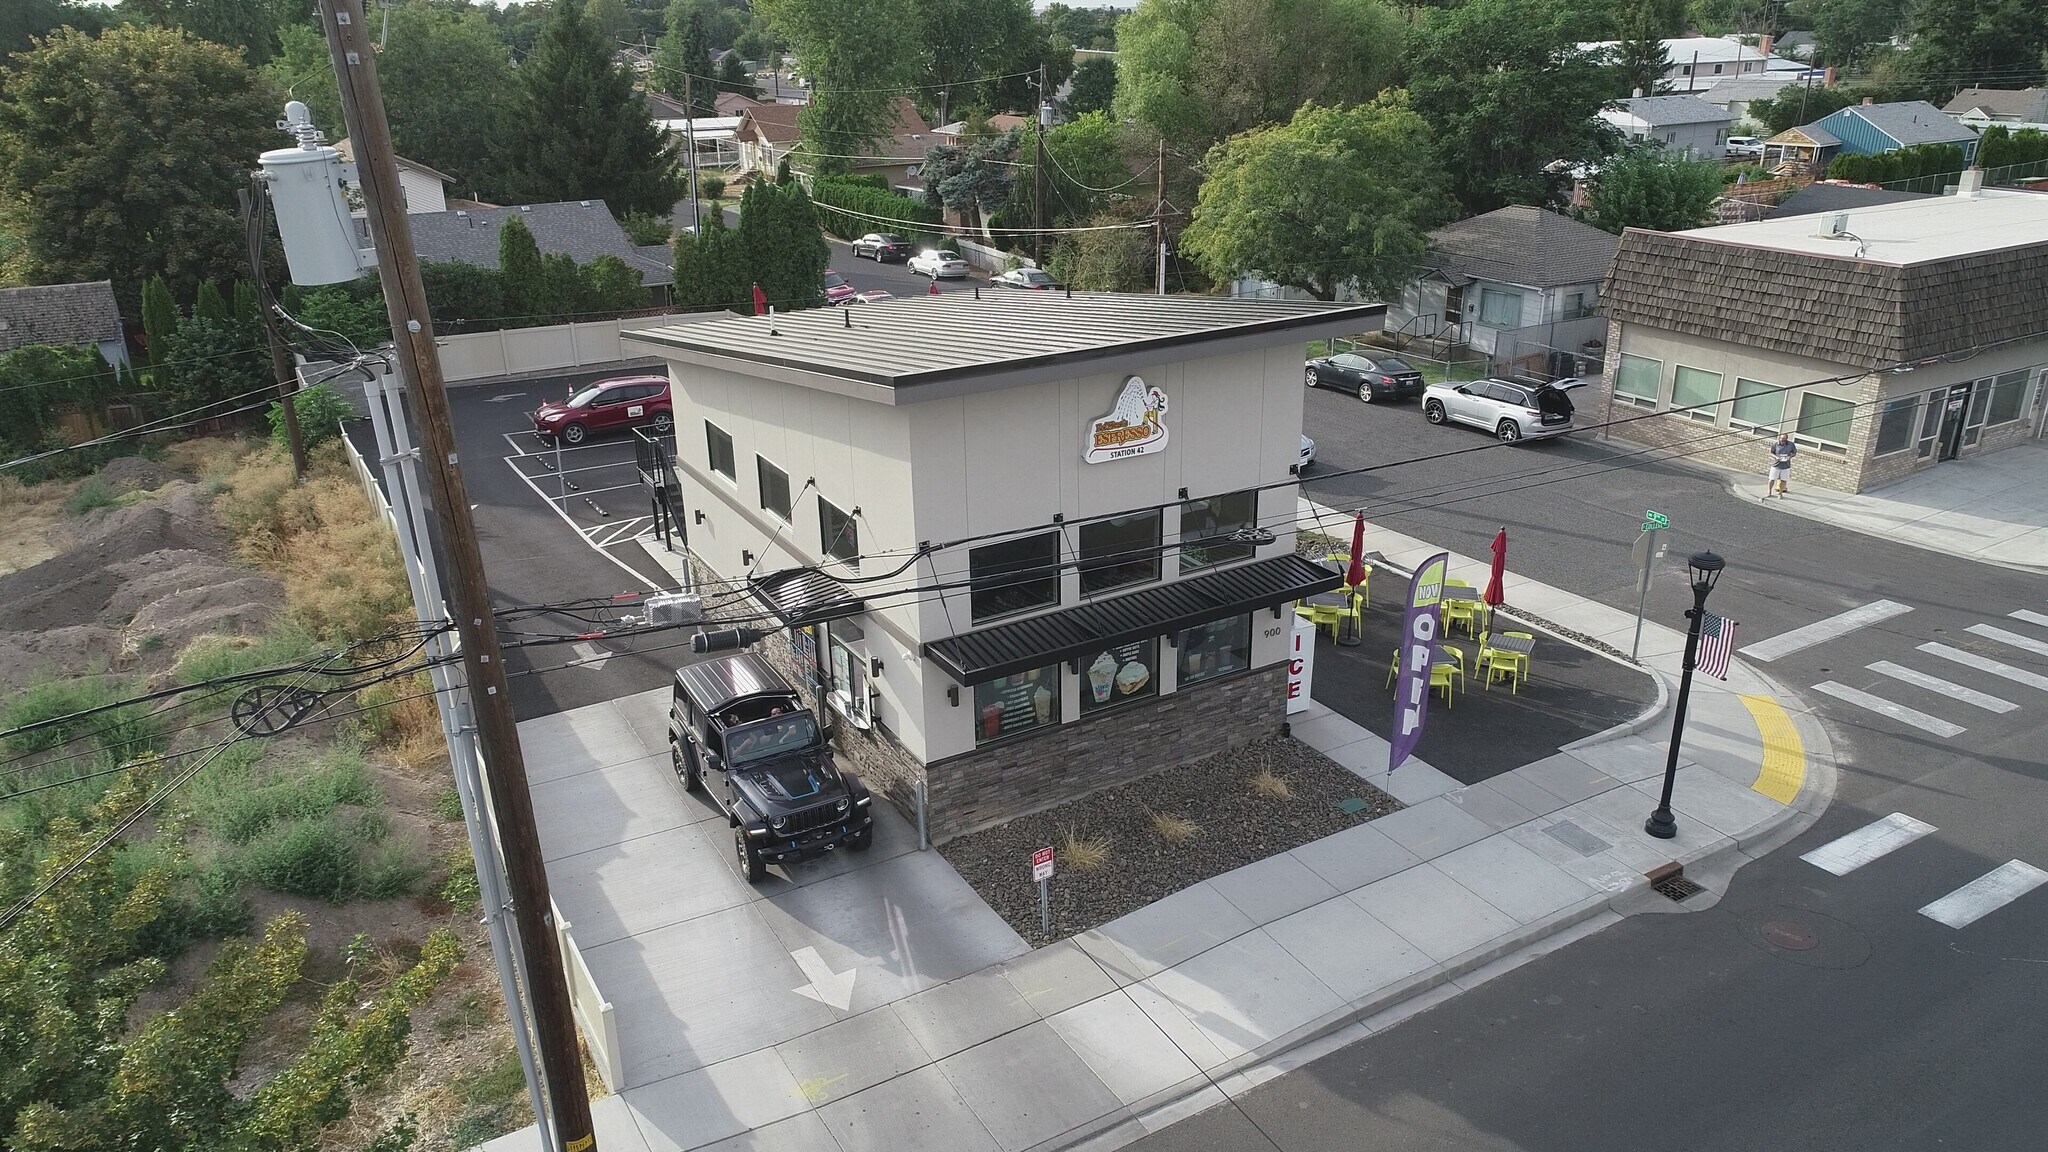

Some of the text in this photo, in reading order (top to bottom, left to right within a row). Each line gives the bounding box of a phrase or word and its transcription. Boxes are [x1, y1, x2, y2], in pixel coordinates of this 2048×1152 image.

[1110, 446, 1145, 459] STATION 42
[1264, 627, 1281, 638] 900
[1287, 634, 1304, 699] ICE
[1036, 863, 1051, 871] WRONG
